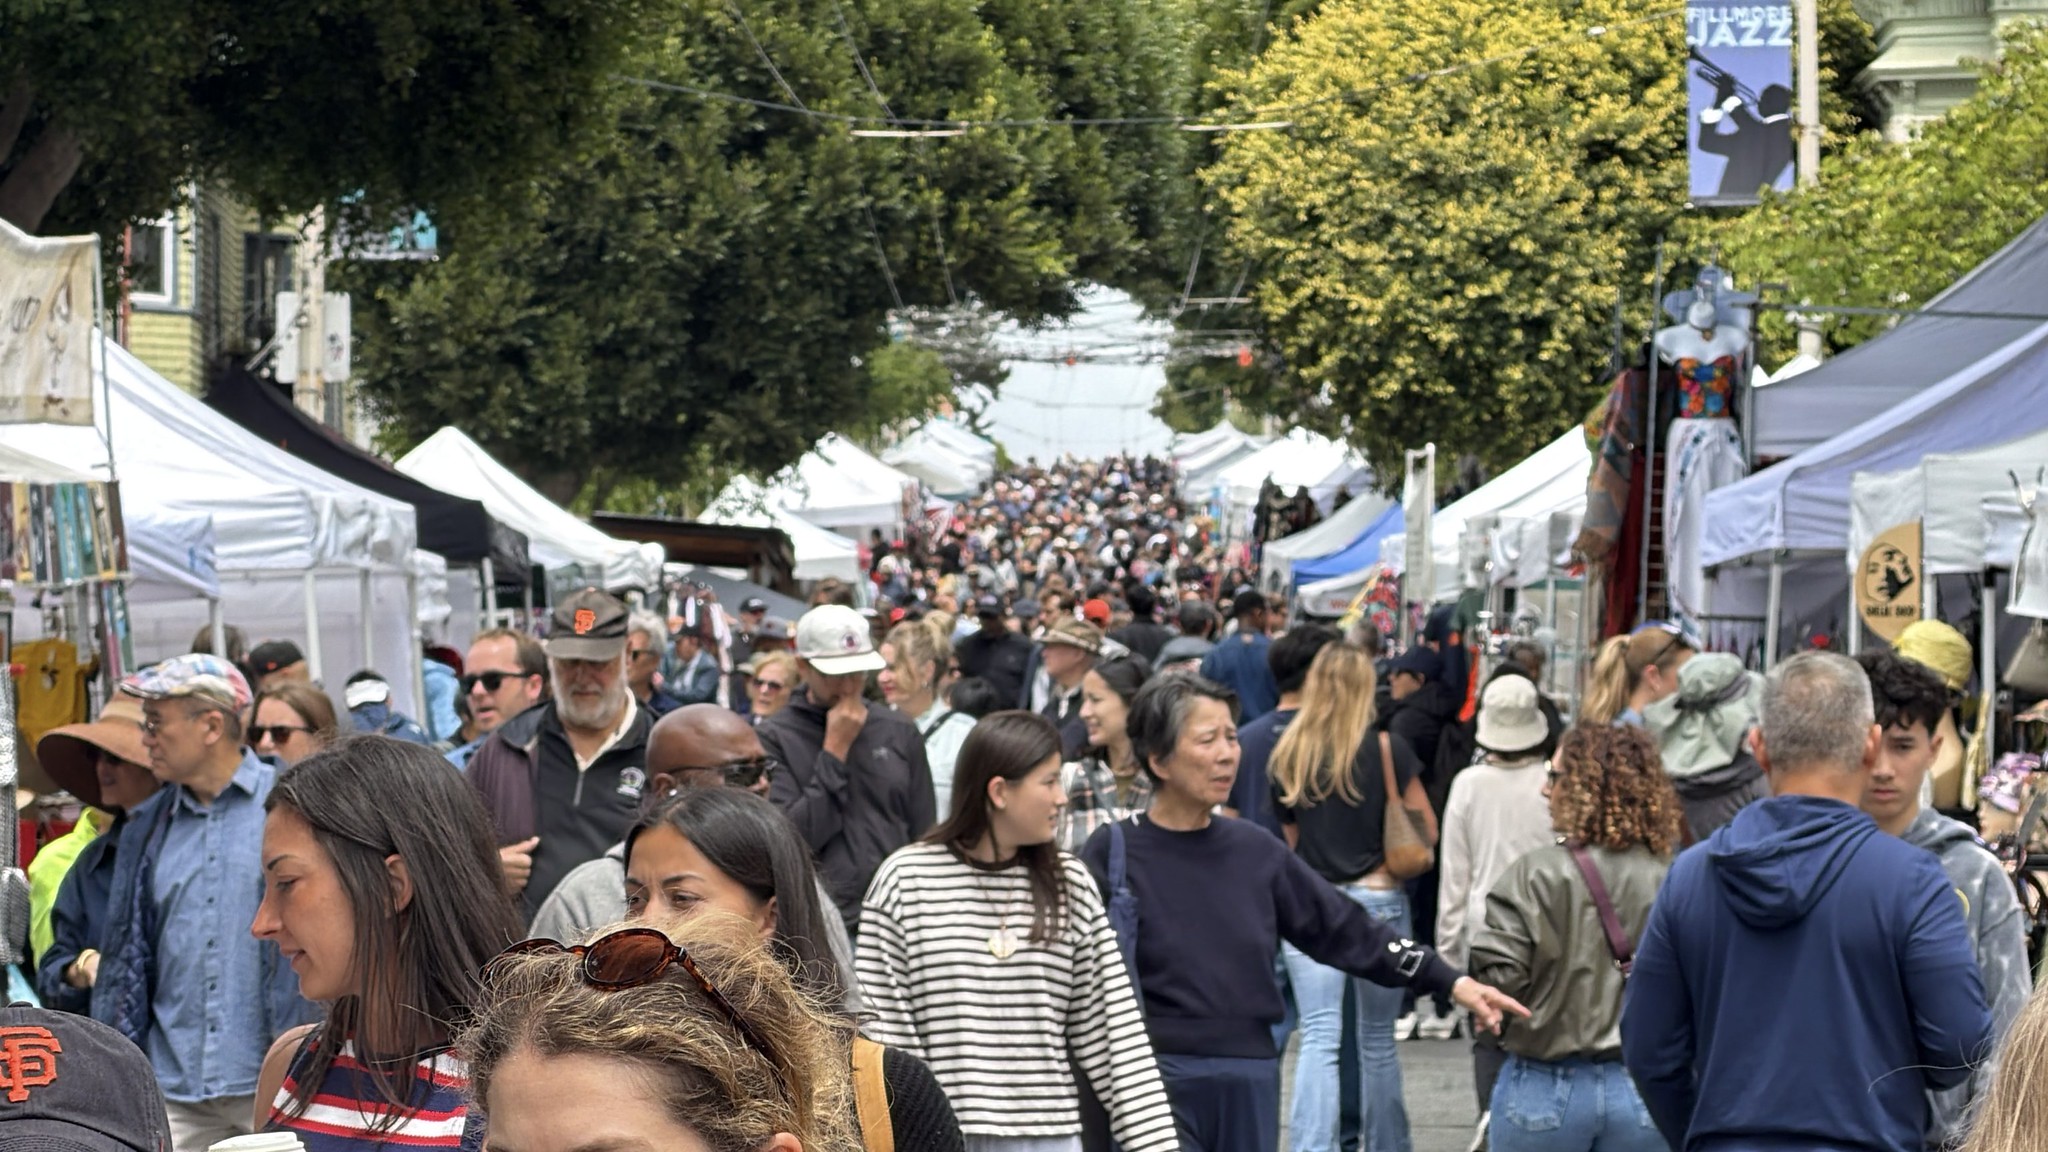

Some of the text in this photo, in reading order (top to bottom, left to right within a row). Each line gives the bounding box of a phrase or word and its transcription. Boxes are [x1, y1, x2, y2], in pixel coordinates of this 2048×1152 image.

[1686, 6, 1793, 23] FILLMORE
[1686, 20, 1793, 47] JAZZ
[0, 1026, 62, 1103] SF
